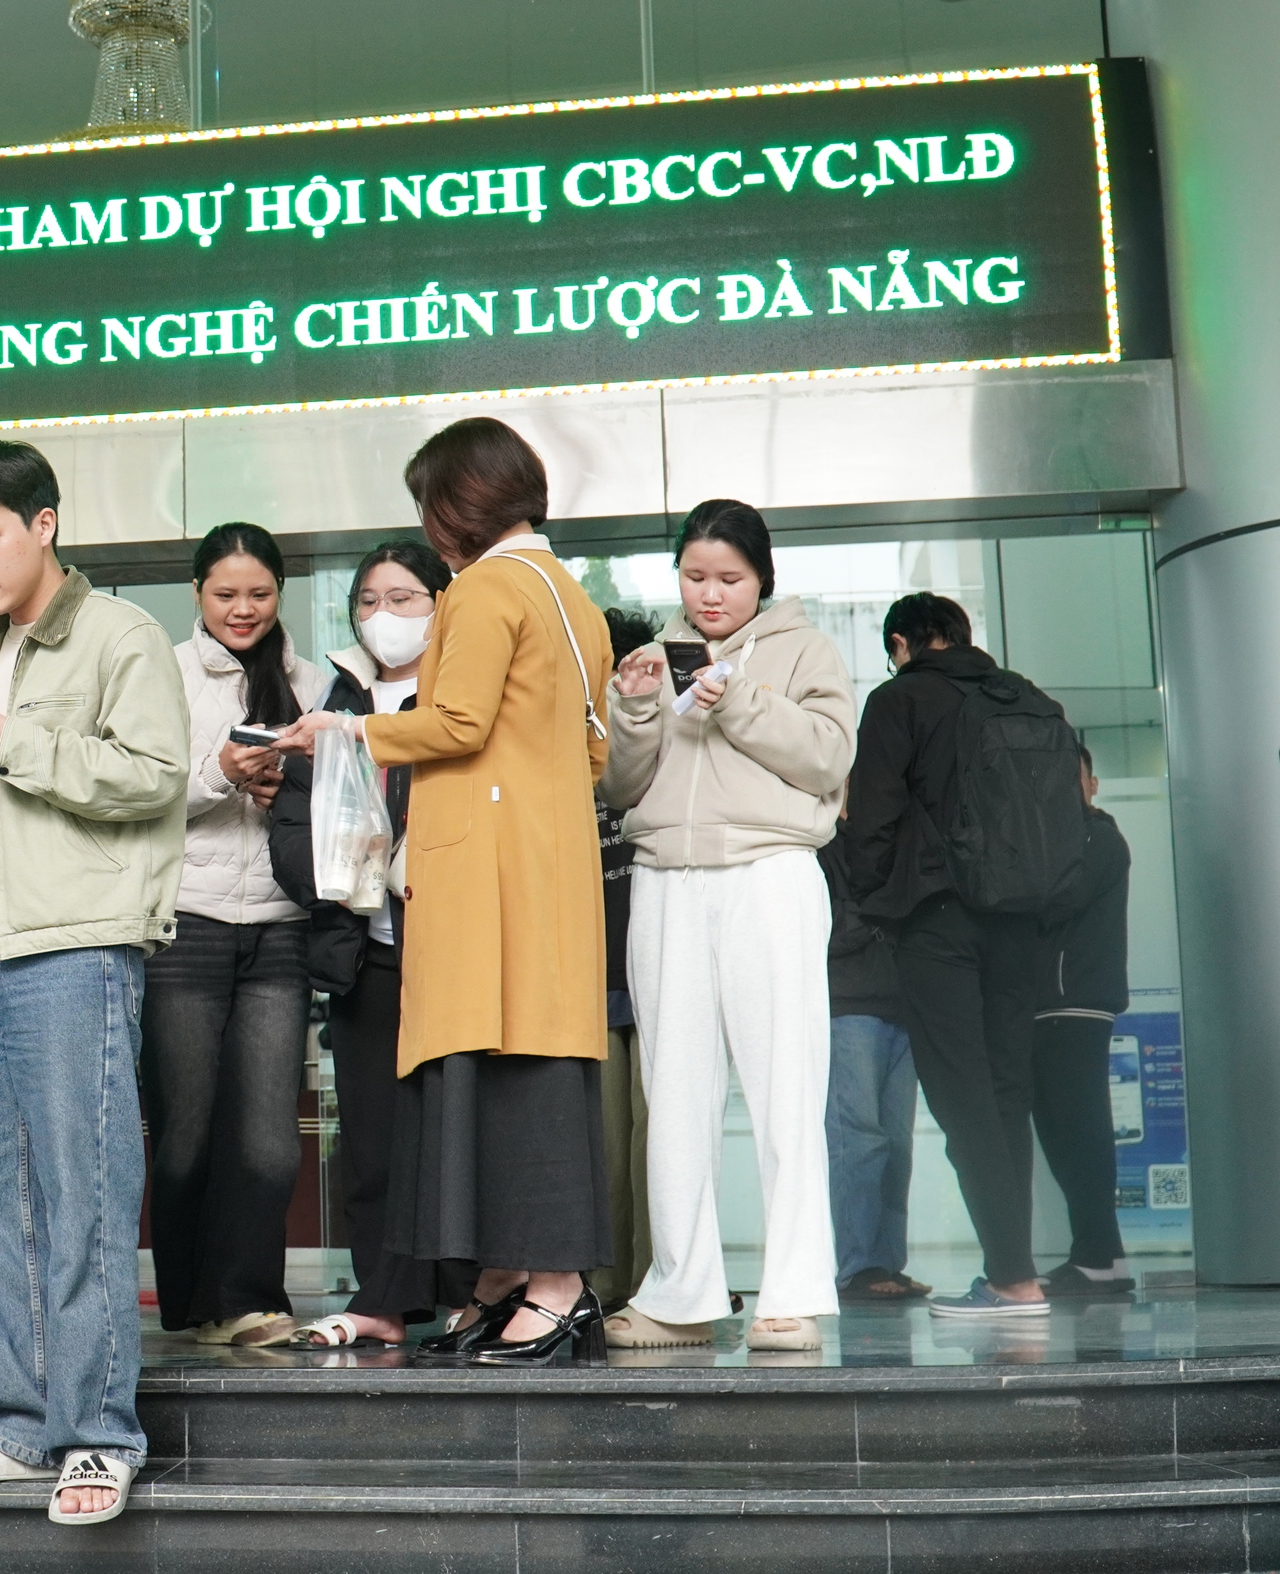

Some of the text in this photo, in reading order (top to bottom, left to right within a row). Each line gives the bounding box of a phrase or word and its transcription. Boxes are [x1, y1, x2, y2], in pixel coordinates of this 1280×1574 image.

[139, 182, 235, 247] DỰ
[245, 175, 366, 239] HỘI
[379, 165, 547, 223] NGHỊ
[563, 133, 1015, 207] CBCC-VC,NLĐ
[100, 300, 277, 364] NGHỆ
[294, 281, 499, 349] CHIẾN
[512, 275, 701, 339] LƯỢC
[716, 259, 814, 321] ĐÀ
[62, 1471, 119, 1483] adidas
